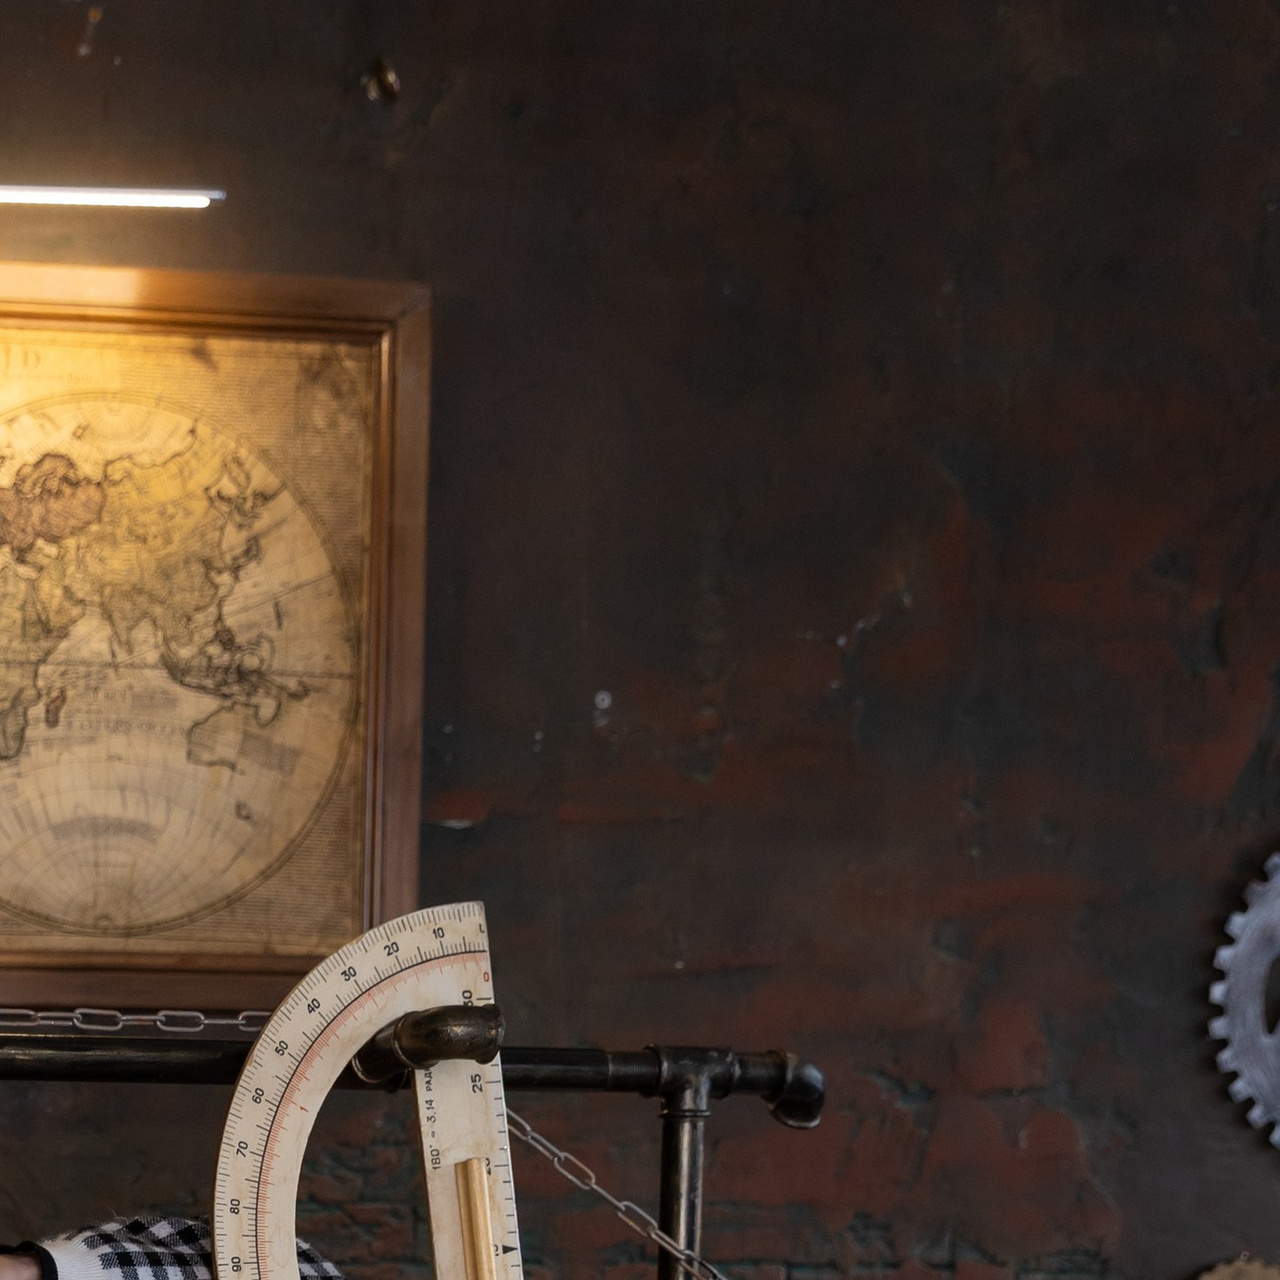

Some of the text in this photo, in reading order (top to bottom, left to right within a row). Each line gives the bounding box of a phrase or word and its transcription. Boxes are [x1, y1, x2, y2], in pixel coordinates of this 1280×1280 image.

[432, 926, 445, 940] 10
[383, 941, 400, 957] 20
[340, 966, 358, 982] 30
[306, 997, 321, 1015] 40
[274, 1040, 290, 1057] 50
[470, 1073, 483, 1094] 25
[251, 1087, 265, 1105] 60
[235, 1140, 249, 1158] 70
[230, 1198, 240, 1215] 80
[231, 1256, 242, 1272] 90
